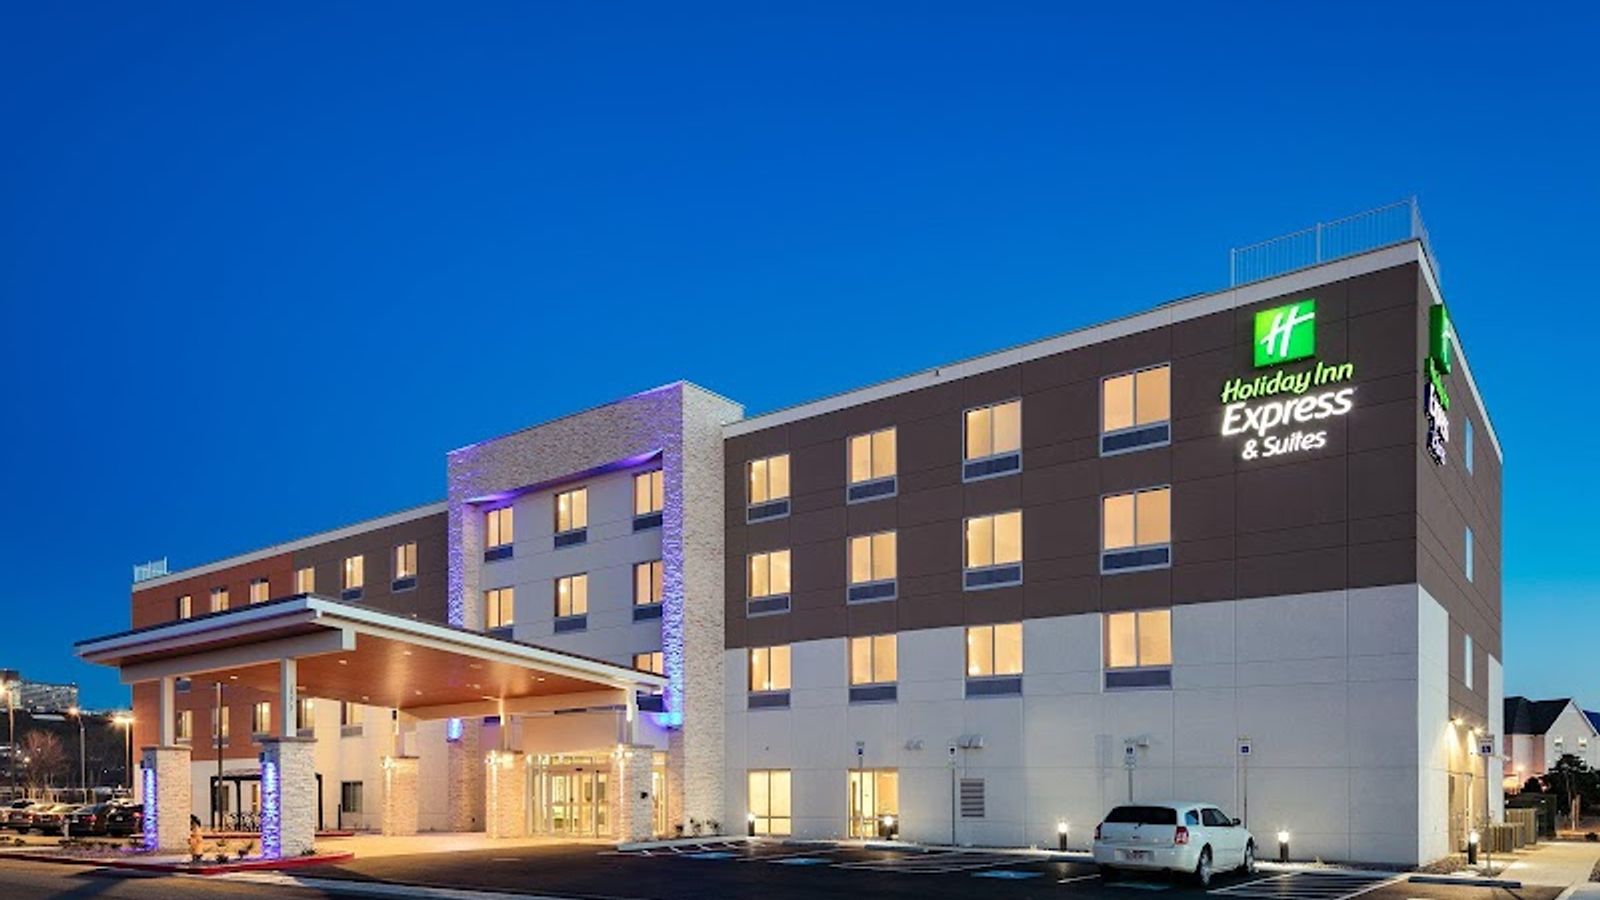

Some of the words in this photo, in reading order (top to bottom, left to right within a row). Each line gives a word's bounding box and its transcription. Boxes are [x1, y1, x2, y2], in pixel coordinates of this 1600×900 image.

[1260, 306, 1315, 357] H
[1221, 370, 1311, 403] Holiday
[1314, 361, 1354, 386] Inn
[1221, 387, 1354, 437] Express
[1242, 438, 1259, 460] &
[1261, 430, 1327, 457] Suites
